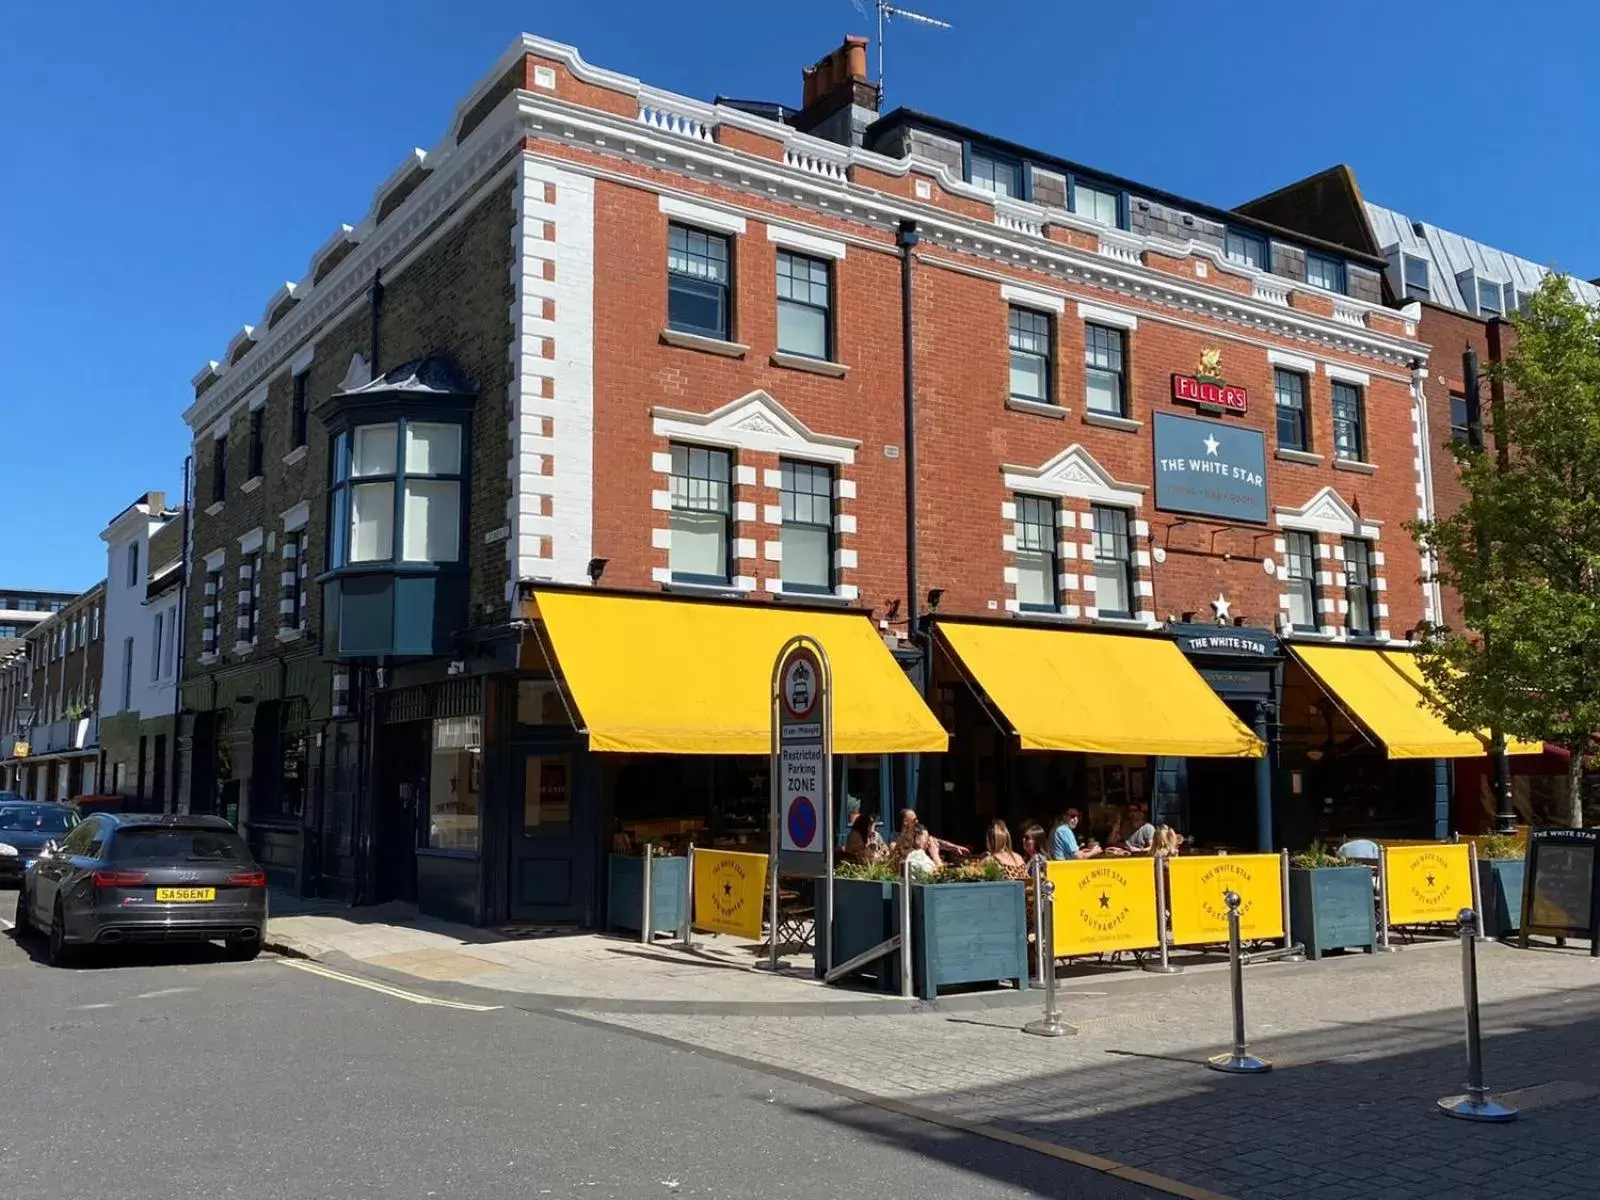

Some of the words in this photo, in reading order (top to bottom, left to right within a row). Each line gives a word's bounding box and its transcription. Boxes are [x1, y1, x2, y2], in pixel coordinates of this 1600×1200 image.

[1160, 459, 1185, 472] THE
[1189, 459, 1229, 476] WHITE
[1232, 467, 1263, 487] STAR
[1189, 637, 1208, 650] THE
[1209, 637, 1240, 648] WHITE
[1241, 640, 1265, 654] STAR
[783, 750, 821, 760] Restricted
[788, 763, 816, 776] Parking
[788, 778, 816, 791] ZONE
[1533, 830, 1548, 838] THE
[1550, 830, 1575, 838] WHITE
[1576, 831, 1597, 840] STAR
[1078, 876, 1090, 890] THE
[1091, 868, 1111, 879] WHITE
[1112, 871, 1127, 887] STAR
[1201, 870, 1214, 884] THE
[1214, 864, 1234, 873] WHITE
[1235, 866, 1252, 881] STAR
[1079, 907, 1130, 932] SOUTHAMPTON
